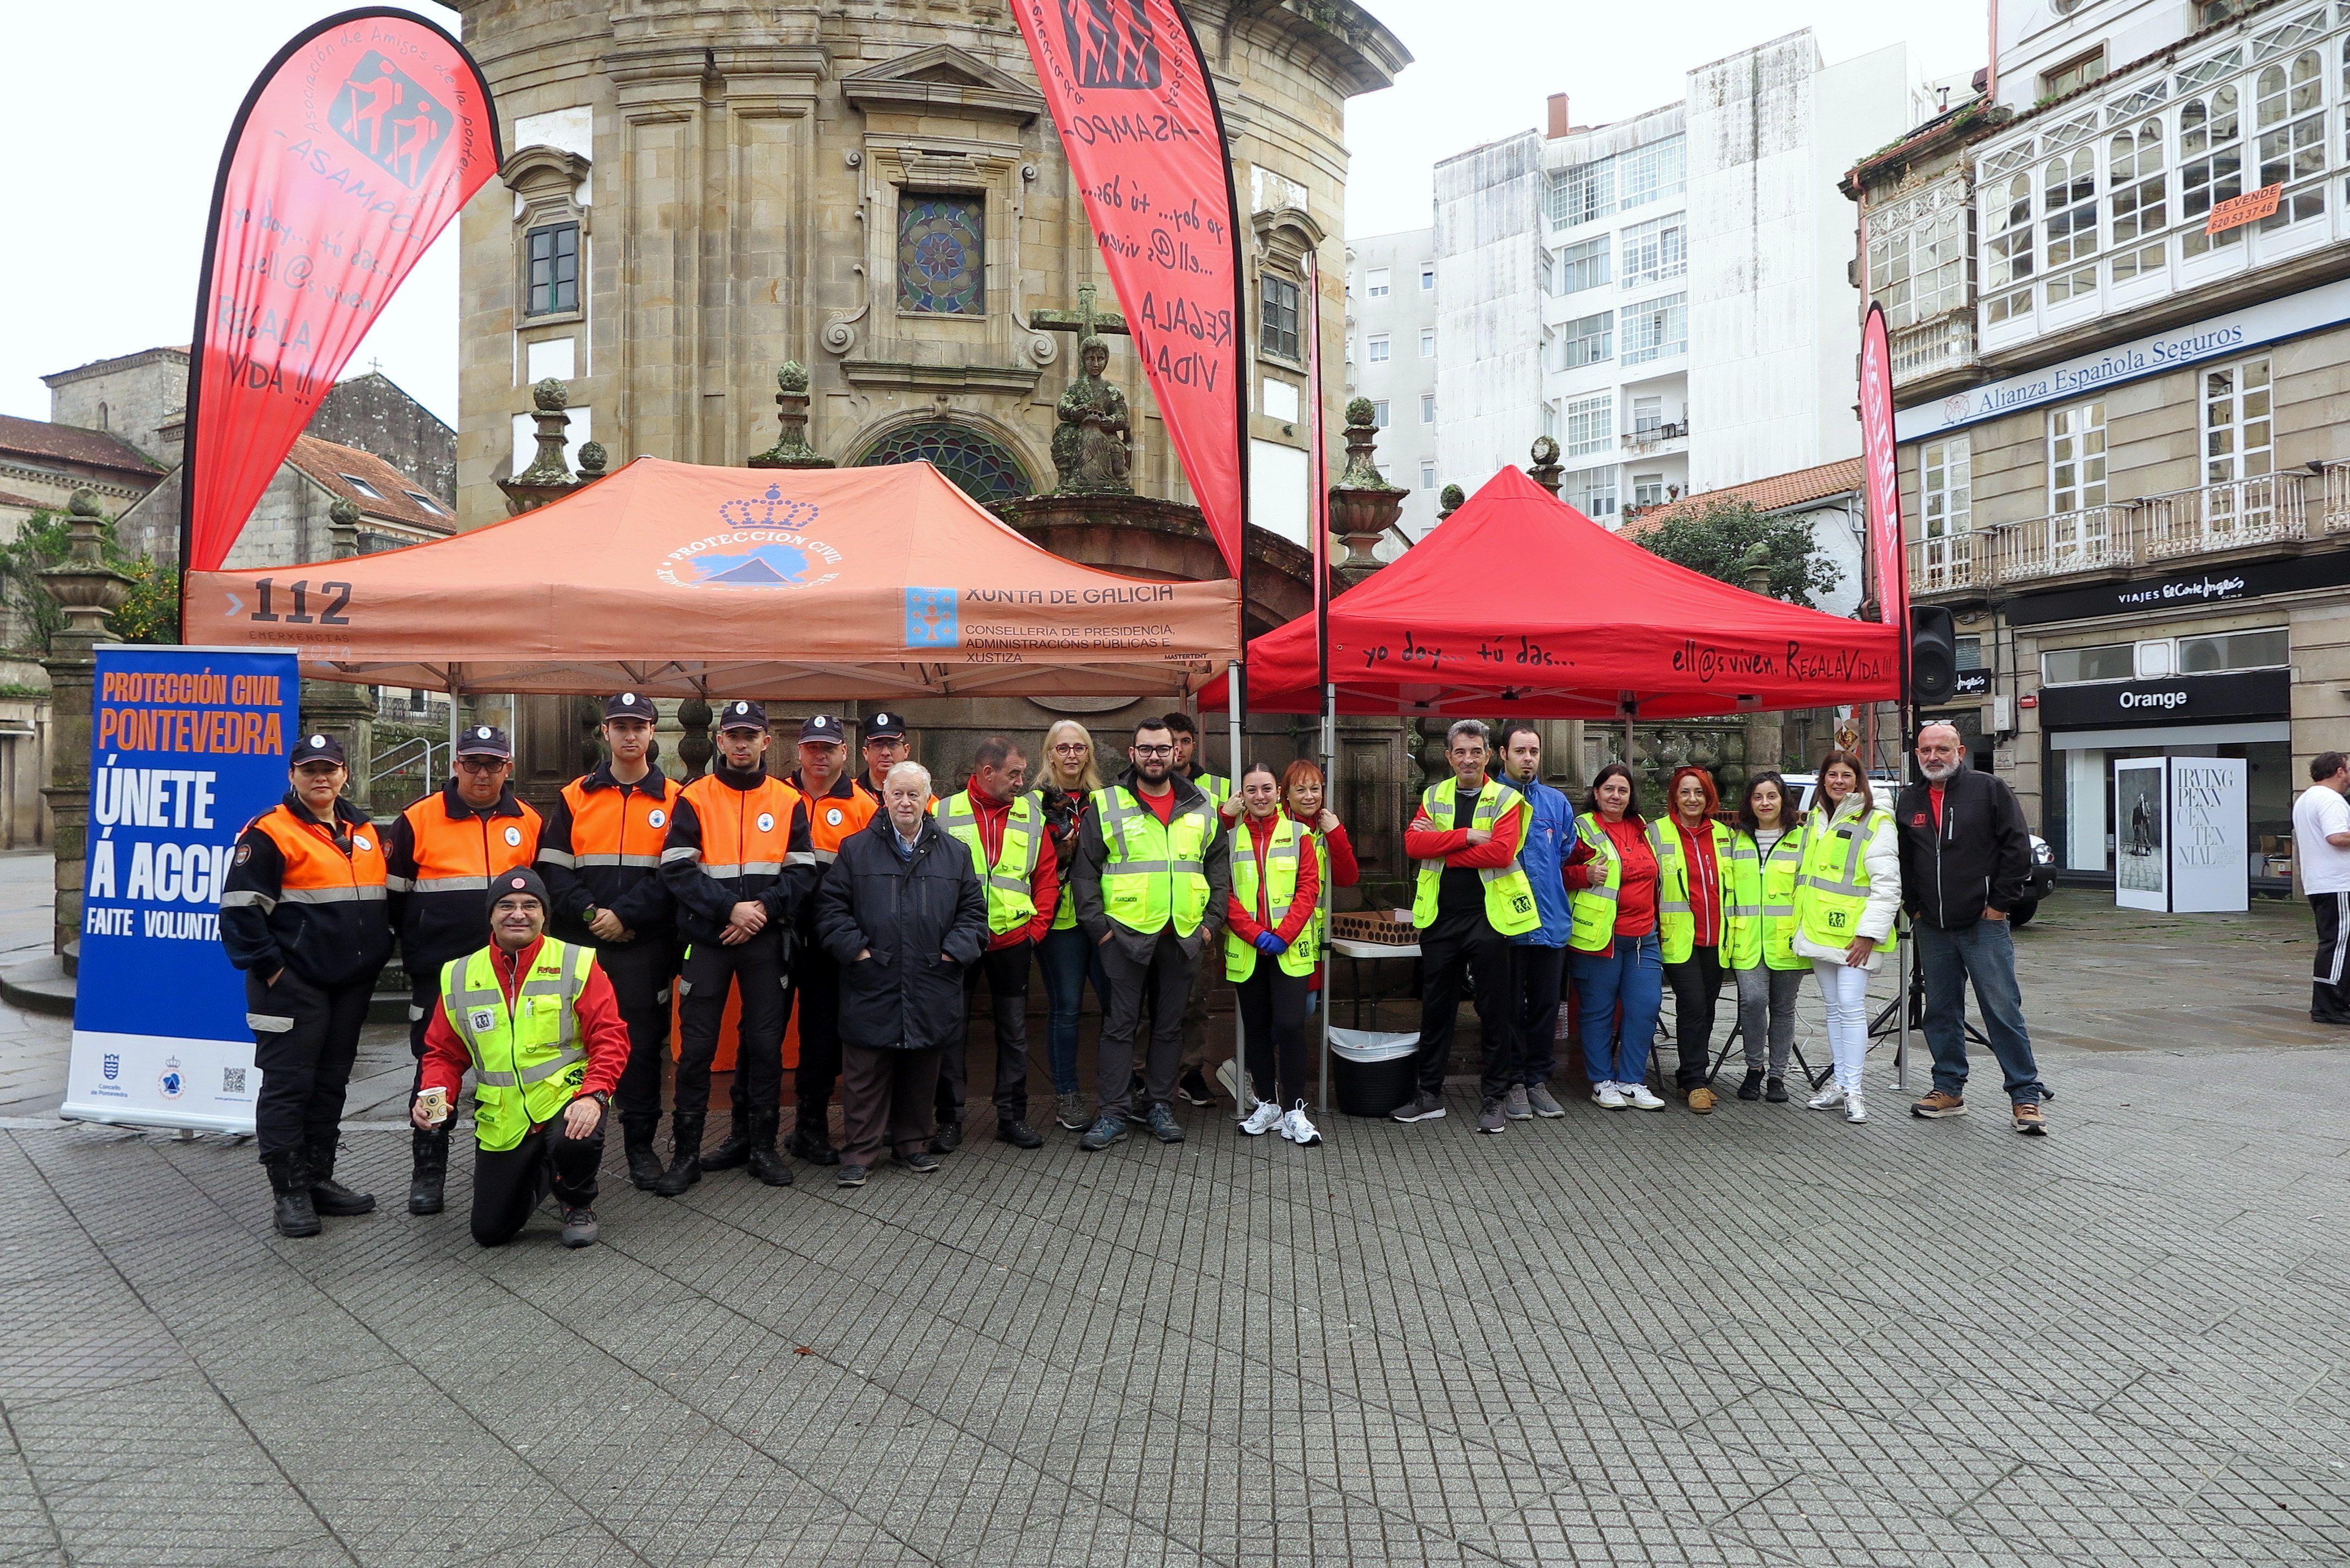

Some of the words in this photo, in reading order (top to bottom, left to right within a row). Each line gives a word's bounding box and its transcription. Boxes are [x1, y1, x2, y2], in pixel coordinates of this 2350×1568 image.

[341, 29, 361, 46] de
[434, 64, 455, 84] de
[2214, 202, 2231, 213] SE
[2234, 185, 2279, 206] VENDE
[2211, 217, 2229, 229] 620
[2231, 212, 2243, 224] 53
[2245, 206, 2258, 219] 37
[218, 295, 312, 353] REGALA
[228, 353, 283, 394] VIDA
[1978, 380, 2048, 413] Alianza
[2055, 349, 2145, 392] Española
[2152, 324, 2243, 364] Seguros
[667, 531, 809, 560] PROTECCION
[807, 540, 843, 565] CIVIL
[251, 578, 352, 625] 112
[966, 589, 1043, 604] XUNTA
[1050, 590, 1078, 604] DE
[1083, 585, 1173, 603] GALICIA
[2118, 590, 2159, 603] VIAJES
[249, 631, 350, 643] EMERXENCIAS
[965, 625, 1058, 637] CONSELLERÍA
[1062, 628, 1080, 637] DE
[1085, 625, 1176, 637] PRESIDENCIA,
[965, 637, 1089, 649] ADMINISTRACIÓNS
[1093, 637, 1158, 648] PÚBLICAS
[1163, 638, 1171, 647] E
[967, 652, 1023, 663] XUSTIZA
[1362, 645, 1389, 669] yo
[1477, 635, 1504, 663] tú
[1516, 635, 1575, 666] das...
[1672, 638, 1724, 683] ell@s
[102, 667, 227, 705] PROTECCIÓN
[231, 674, 283, 706] CIVIL
[2119, 691, 2187, 709] Orange
[99, 708, 283, 755] PONTEVEDRA
[95, 754, 217, 830] ÚNETE
[2178, 768, 2234, 788] IRVING
[2178, 788, 2221, 807] PENN
[2177, 807, 2210, 826] CEN
[2191, 826, 2226, 845] TEN
[89, 827, 116, 898] Á
[86, 908, 134, 937] FAITE
